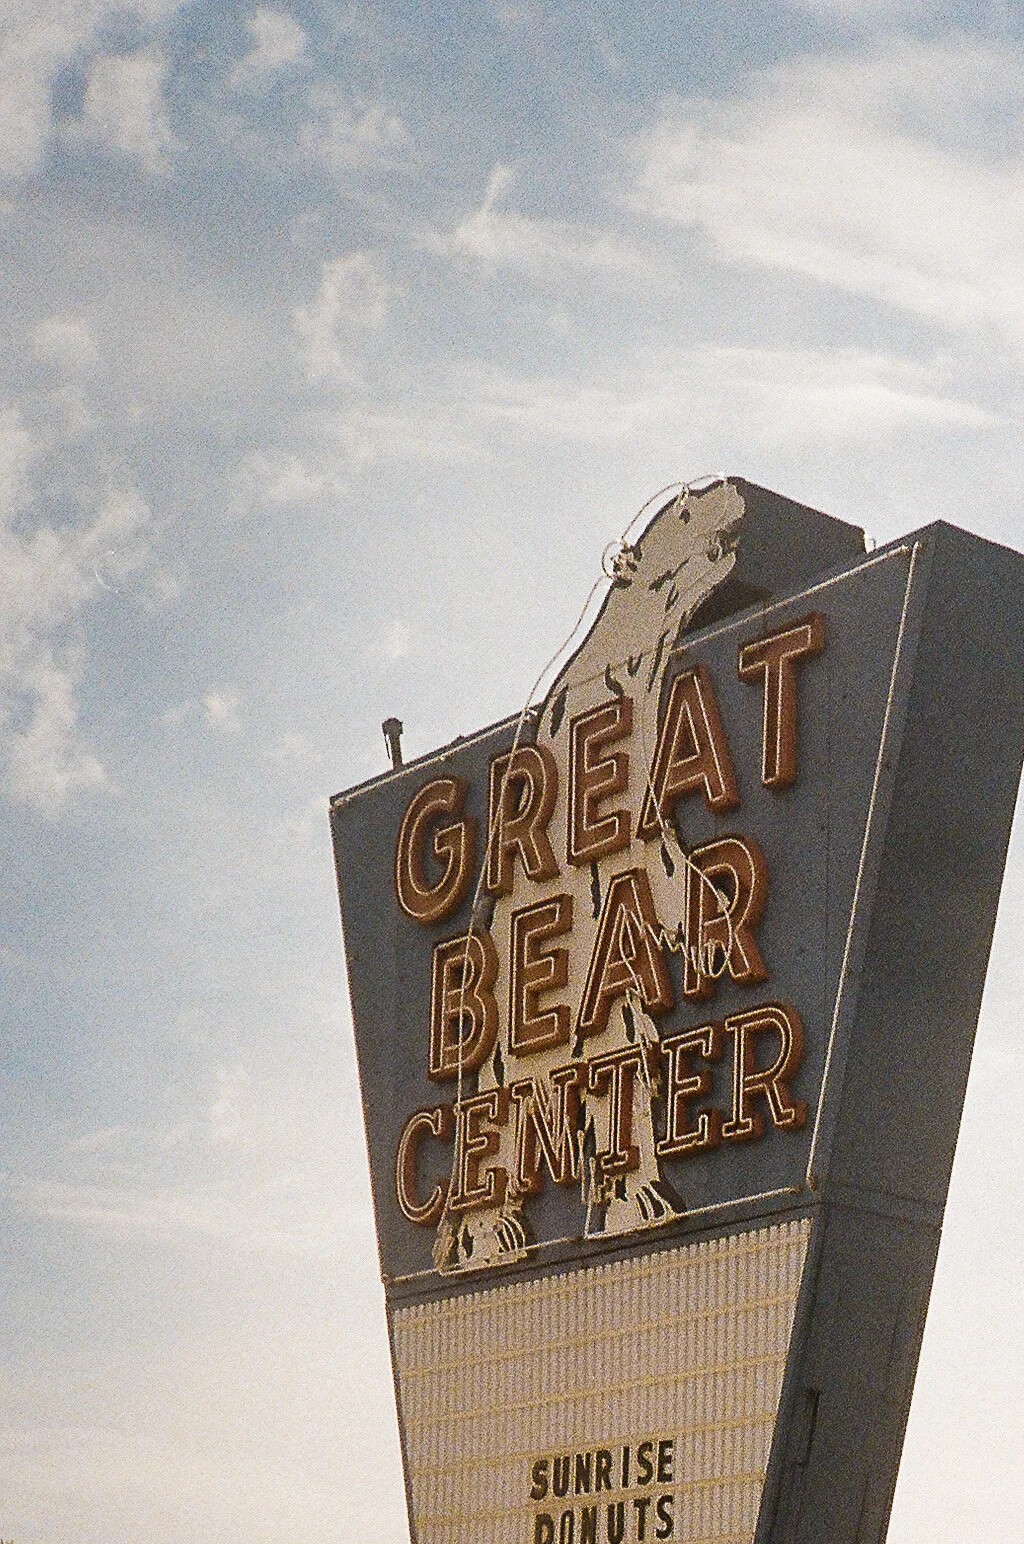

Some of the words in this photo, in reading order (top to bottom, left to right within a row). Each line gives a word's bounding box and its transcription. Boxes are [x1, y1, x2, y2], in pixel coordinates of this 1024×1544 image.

[395, 611, 825, 925] GREAT
[427, 833, 768, 1082] BEAR
[396, 1003, 808, 1227] CENTER
[530, 1440, 674, 1500] SUNRISE
